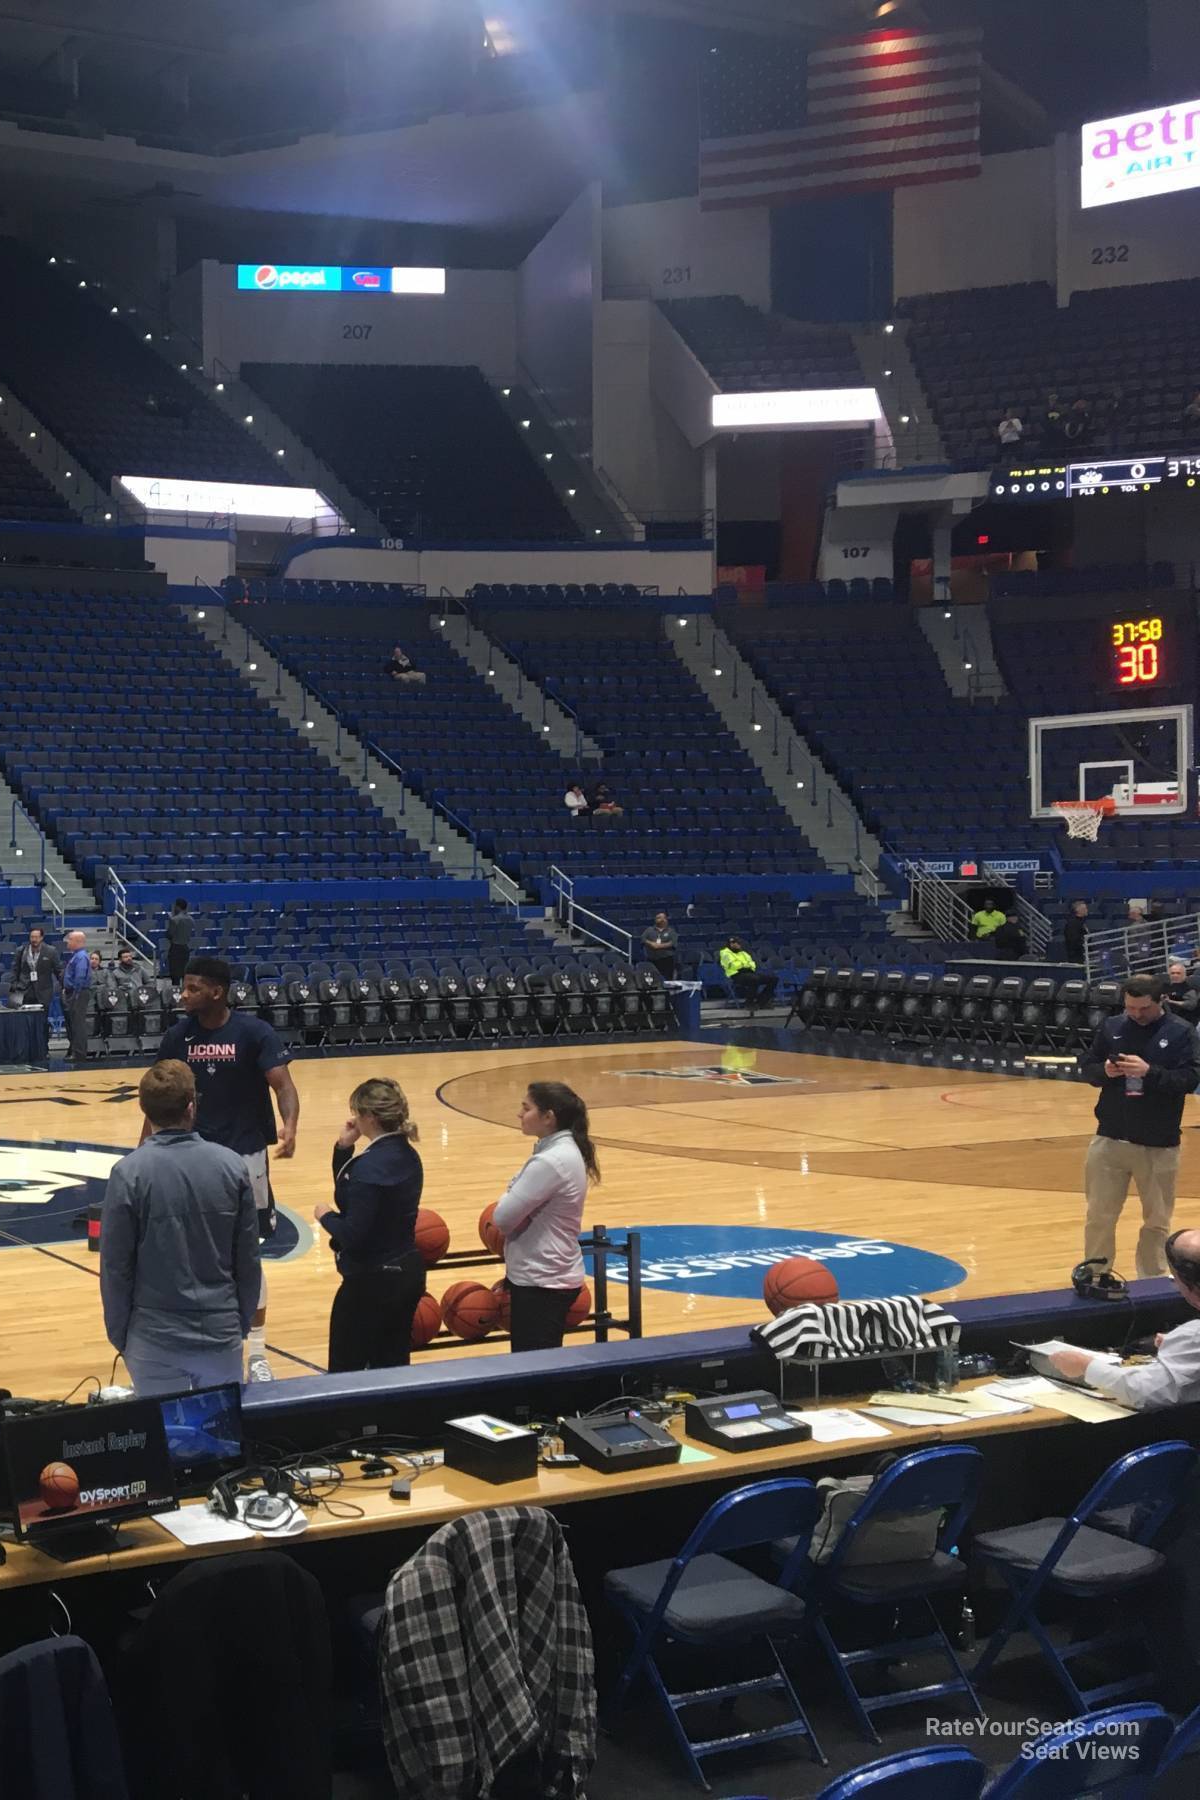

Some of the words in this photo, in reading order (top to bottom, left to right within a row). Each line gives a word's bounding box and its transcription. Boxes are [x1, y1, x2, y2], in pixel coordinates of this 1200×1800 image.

[1126, 155, 1173, 175] AIR
[1091, 245, 1129, 265] 232
[662, 266, 691, 284] 231
[343, 324, 373, 340] 207
[1131, 464, 1146, 479] 0
[381, 537, 404, 550] 106
[843, 547, 870, 559] 107
[1113, 618, 1162, 646] 37:58
[1120, 643, 1158, 683] 30
[1008, 861, 1038, 869] LIGHT
[188, 1044, 235, 1056] UCONN
[62, 1437, 106, 1459] Instant
[108, 1428, 147, 1453] Replay
[131, 1480, 146, 1494] HD
